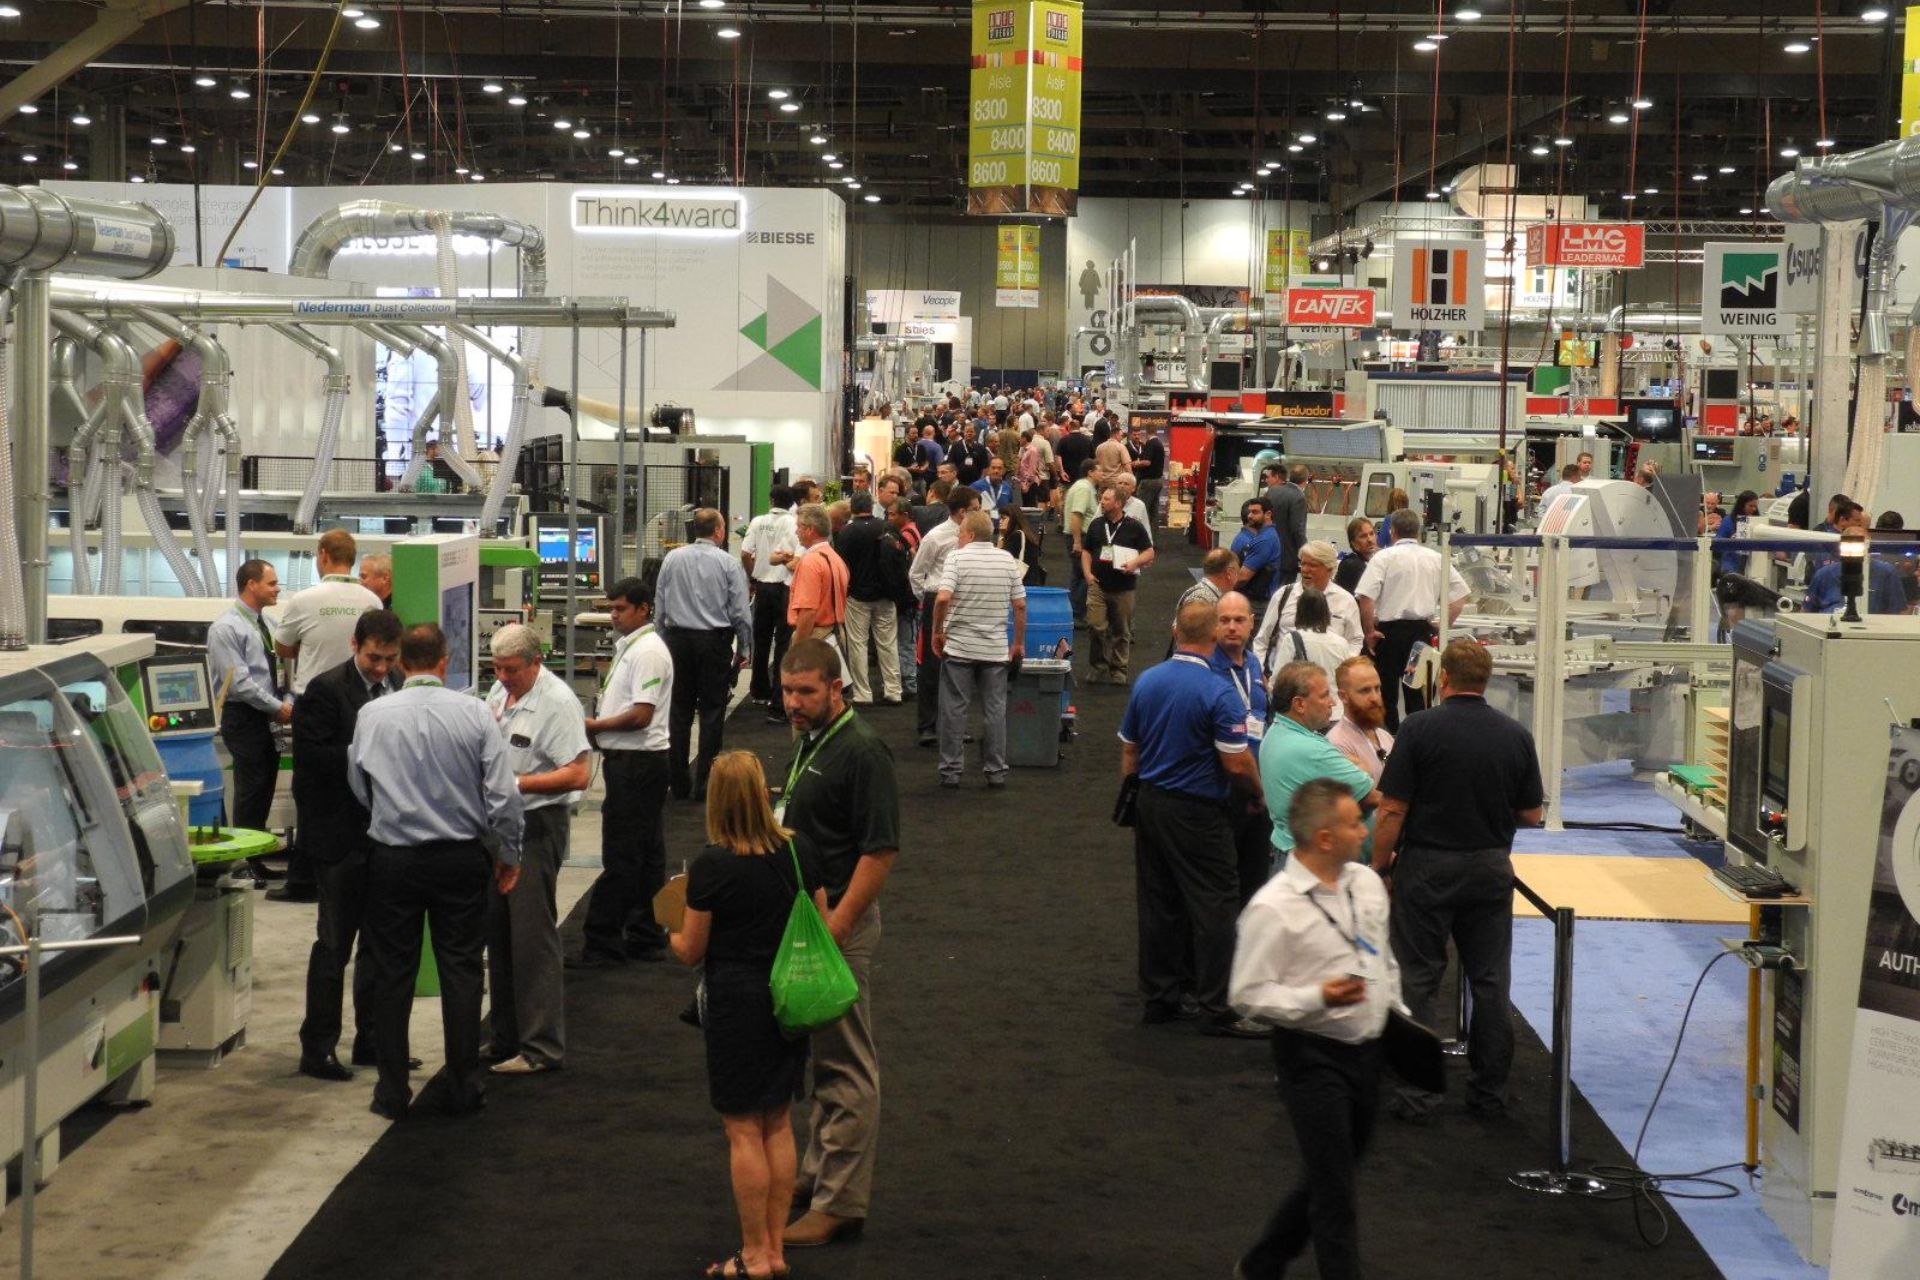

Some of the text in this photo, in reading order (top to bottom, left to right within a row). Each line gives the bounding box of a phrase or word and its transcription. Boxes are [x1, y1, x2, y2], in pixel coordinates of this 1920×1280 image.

[989, 74, 1012, 91] Aisle
[1046, 75, 1065, 91] Aisle
[973, 97, 1007, 121] 8300
[1032, 96, 1062, 121] 8300
[991, 128, 1025, 150] 8400
[1047, 129, 1076, 154] 8400
[973, 161, 1007, 184] 8600
[1031, 160, 1060, 183] 8600
[577, 197, 738, 229] Think4ward
[760, 231, 815, 244] BIESSE
[1561, 228, 1626, 252] LMG
[1561, 253, 1625, 263] LEADERMAC
[298, 302, 451, 313] Nederman Dust Collection
[1294, 294, 1367, 319] CANTEK
[1410, 308, 1466, 321] HOLZHER
[1720, 313, 1777, 326] WEINIG
[1283, 404, 1332, 417] salvador
[319, 607, 357, 616] SERVICE
